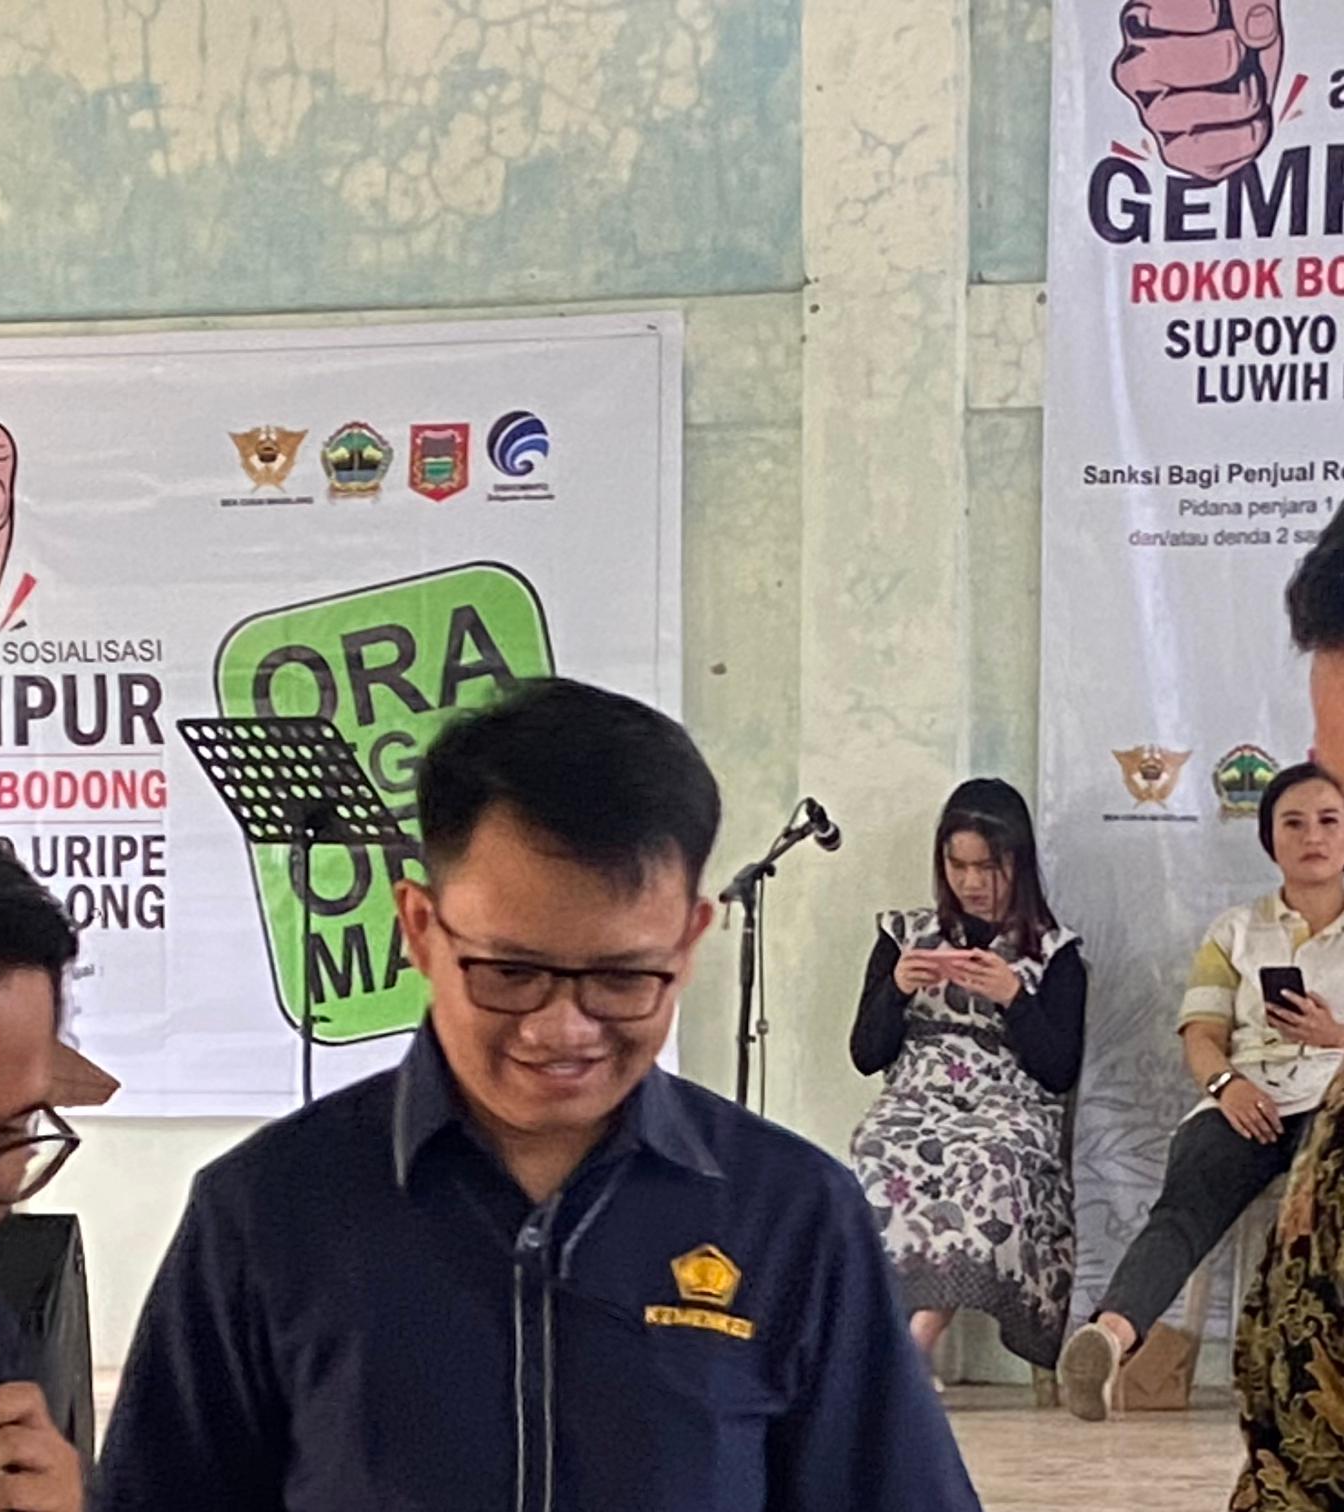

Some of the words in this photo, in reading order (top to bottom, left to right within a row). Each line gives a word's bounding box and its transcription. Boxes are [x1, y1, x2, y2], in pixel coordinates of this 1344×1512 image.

[1131, 259, 1283, 303] ROKOK
[1164, 314, 1336, 359] SUPOYO
[1197, 363, 1328, 404] LUWIH
[1083, 464, 1160, 485] Sanksi
[1168, 464, 1220, 489] Bagi
[1227, 462, 1315, 488] Penjual
[1179, 499, 1242, 517] Pidana
[1248, 498, 1318, 519] penjara
[1213, 529, 1271, 545] denda
[1276, 527, 1288, 544] 2
[2, 640, 163, 664] SOSIALISASI
[252, 603, 519, 727] ORA
[32, 835, 167, 878] URIPE
[65, 883, 165, 930] ONG
